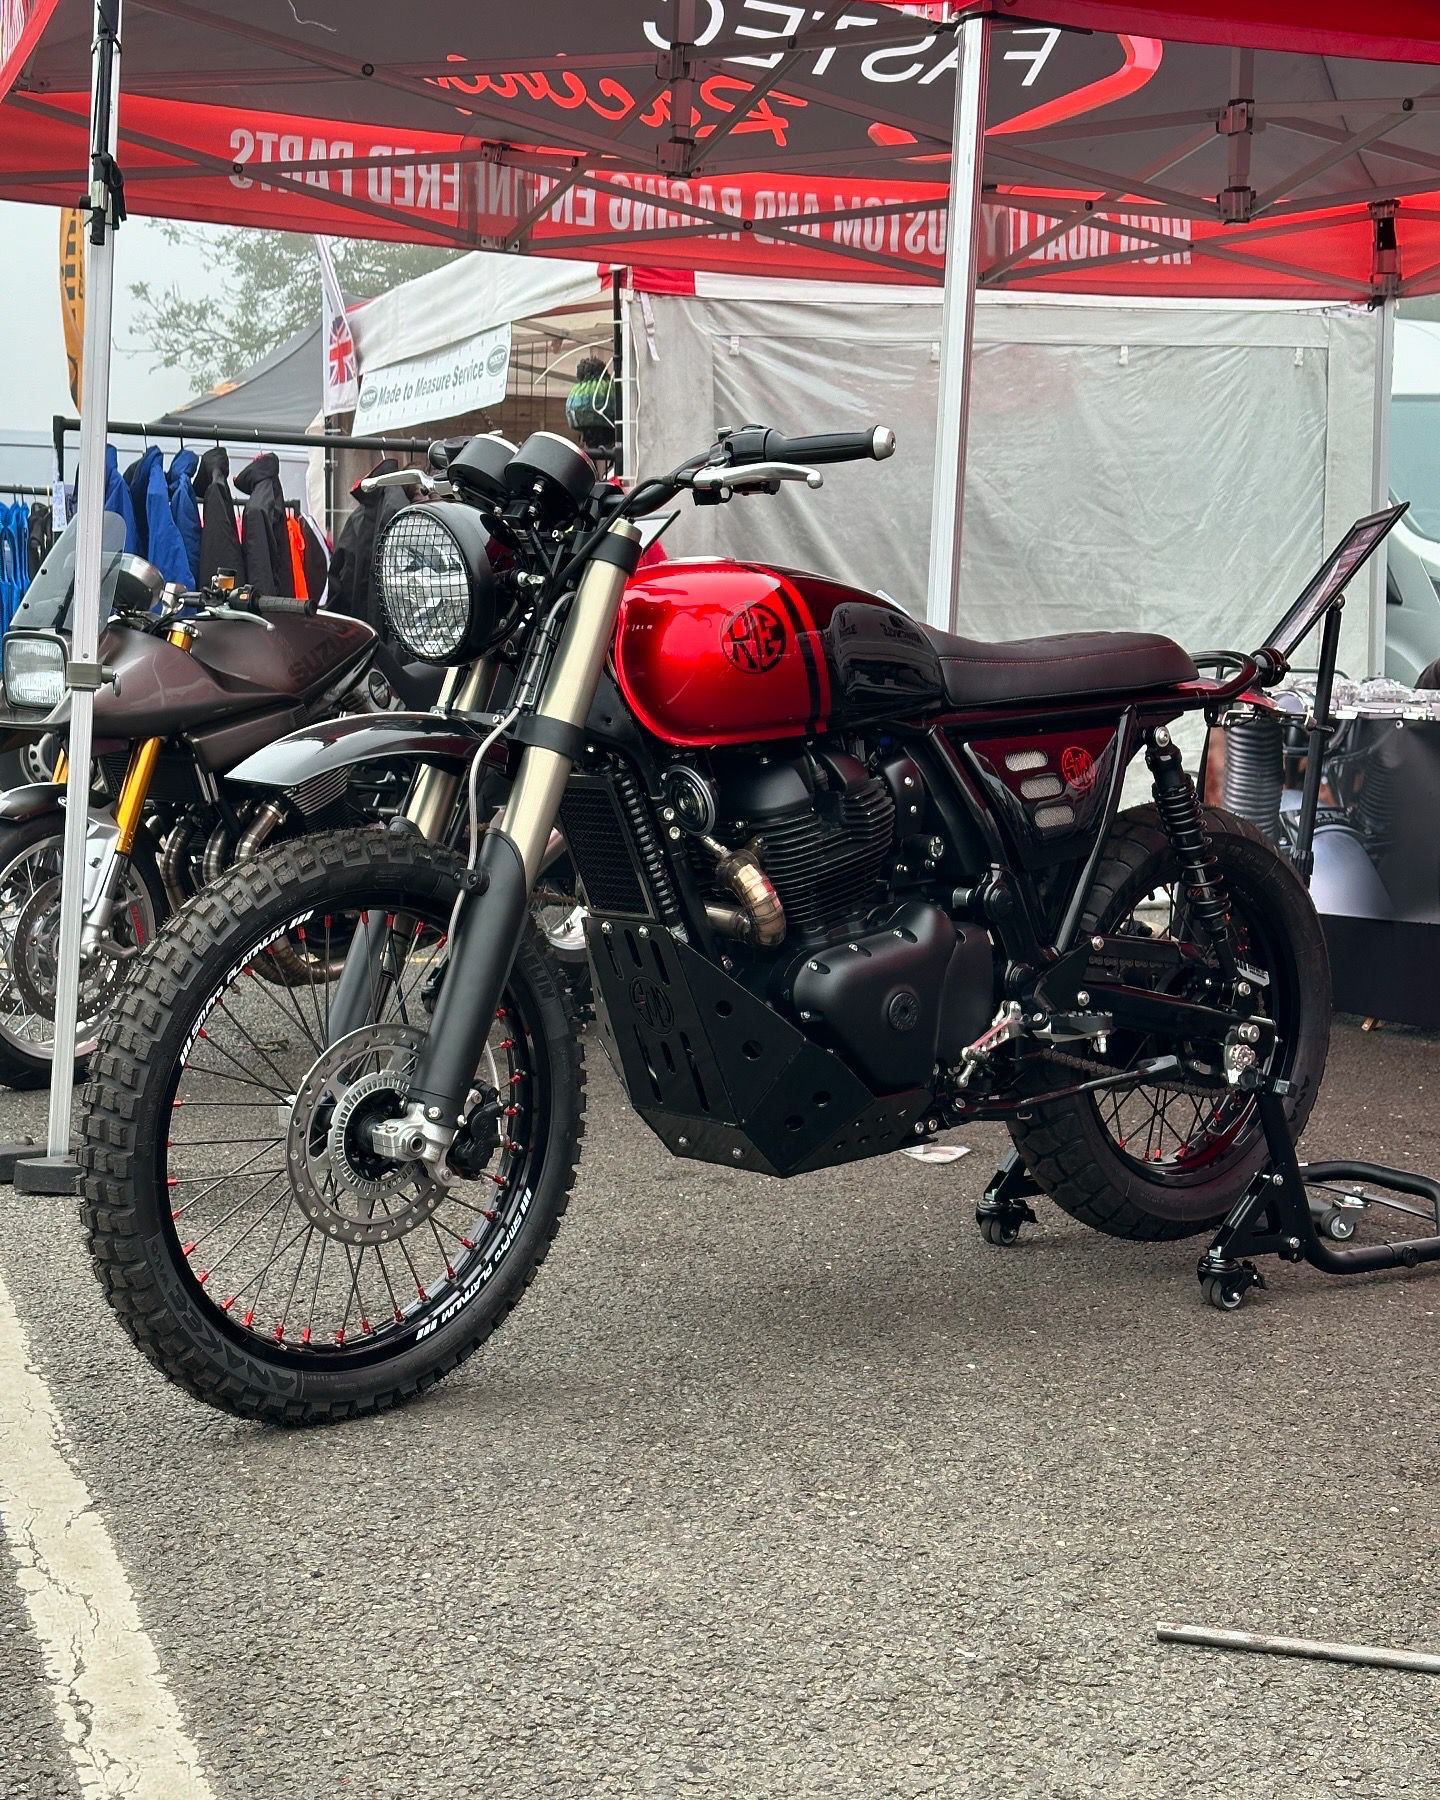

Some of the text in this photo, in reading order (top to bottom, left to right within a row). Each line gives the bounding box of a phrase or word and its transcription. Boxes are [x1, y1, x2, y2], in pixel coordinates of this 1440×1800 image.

[377, 384, 401, 406] Made
[403, 382, 413, 400] to
[414, 374, 451, 398] Measure
[452, 358, 484, 388] Service
[226, 924, 286, 985] PLATINUM
[441, 1262, 493, 1323] PLATINUM
